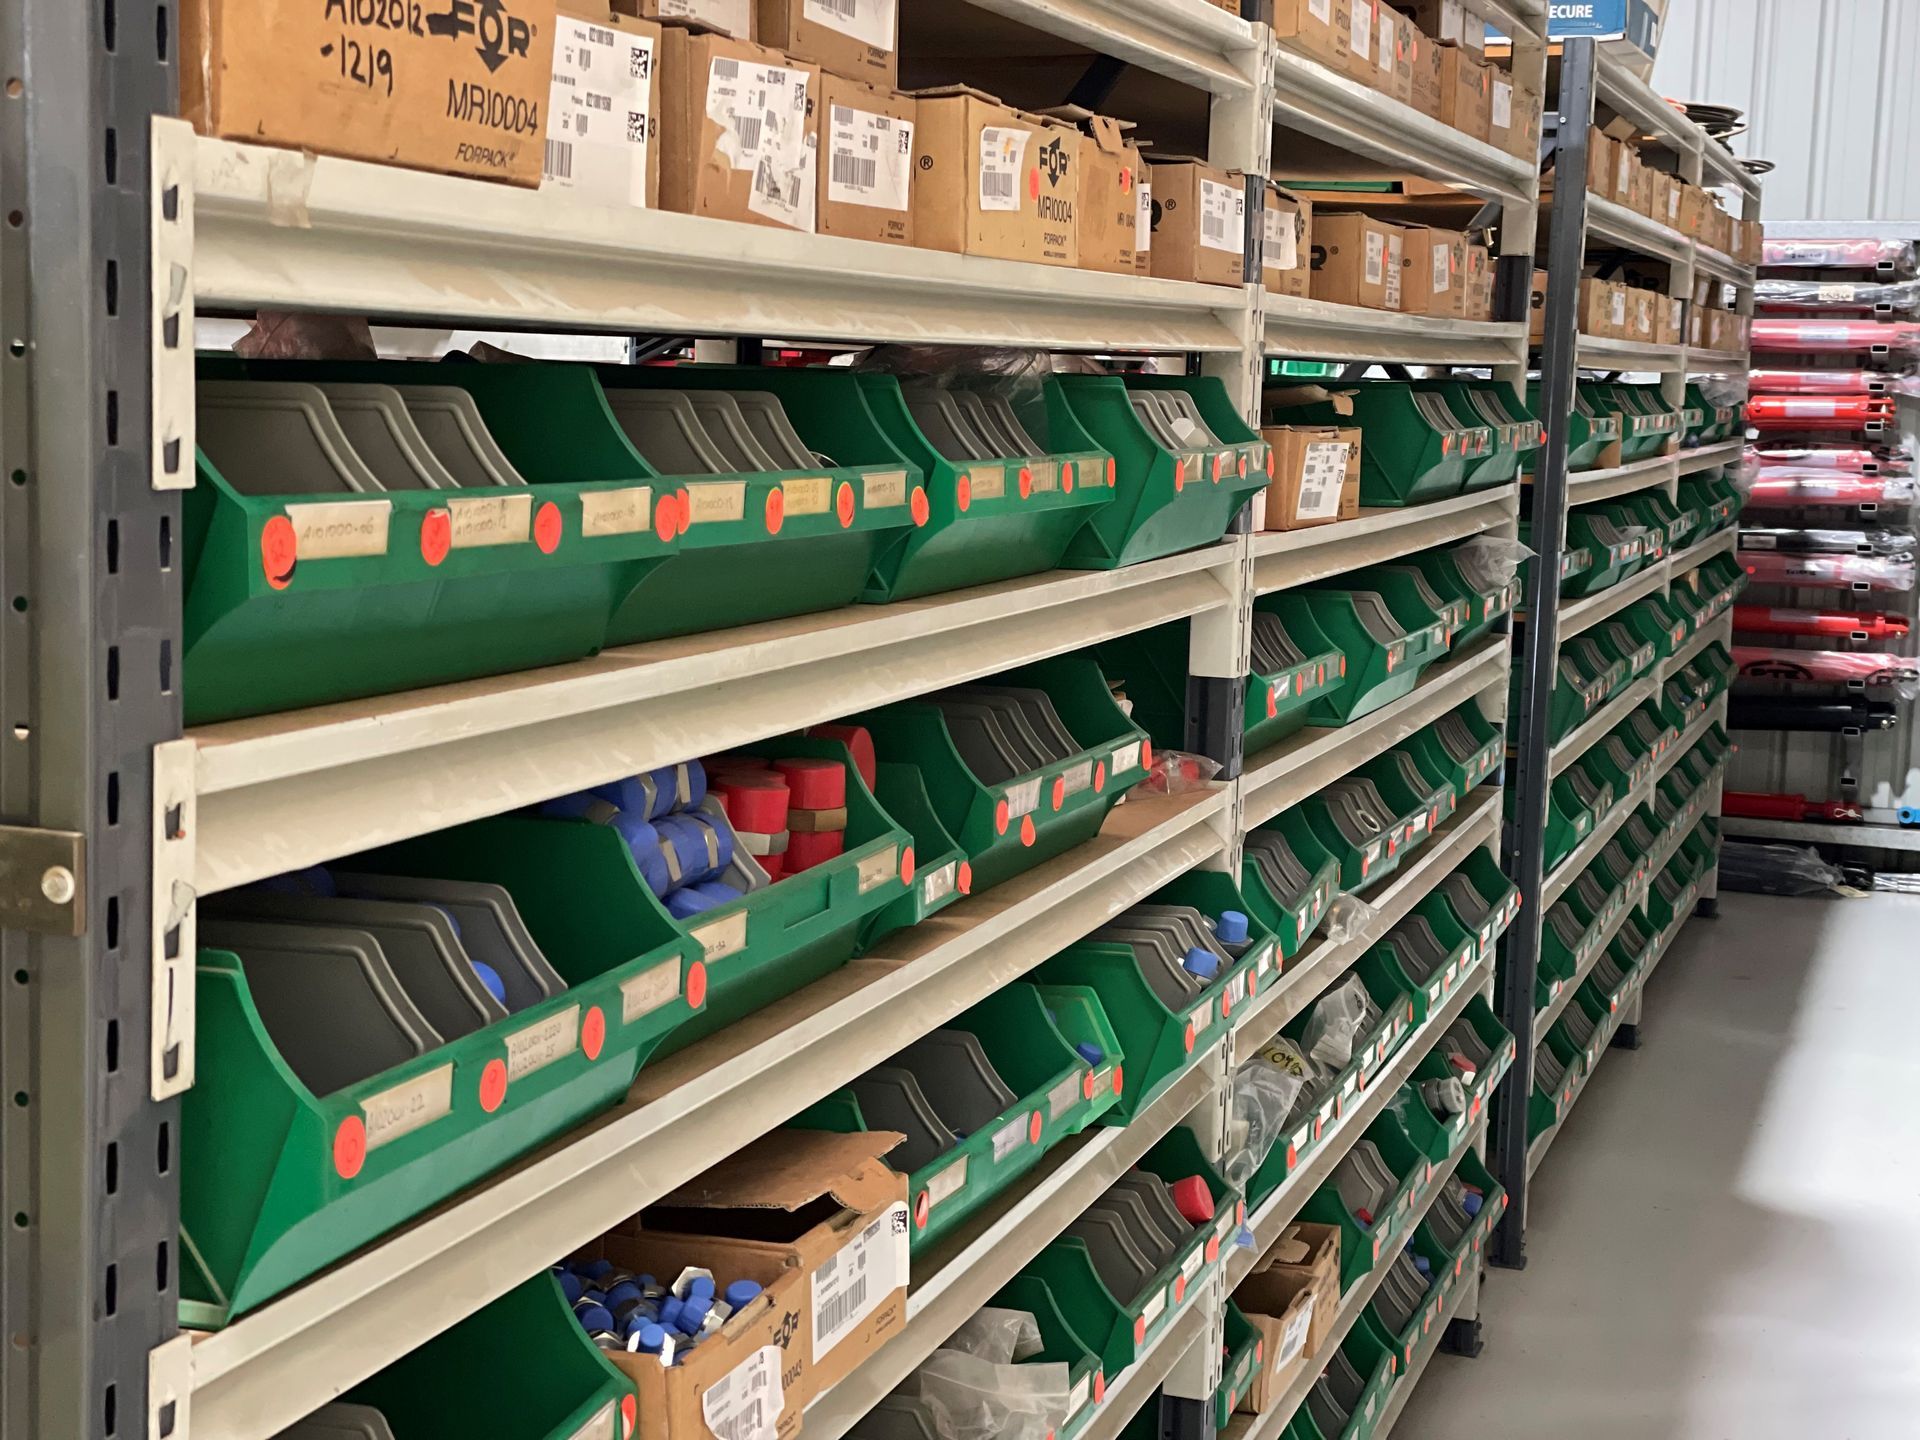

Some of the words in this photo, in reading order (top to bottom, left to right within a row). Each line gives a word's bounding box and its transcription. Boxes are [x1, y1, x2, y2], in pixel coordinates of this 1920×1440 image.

[1549, 5, 1593, 19] ECURE
[452, 2, 530, 57] FOR
[455, 143, 509, 168] FORPACK
[1039, 146, 1068, 176] FOR
